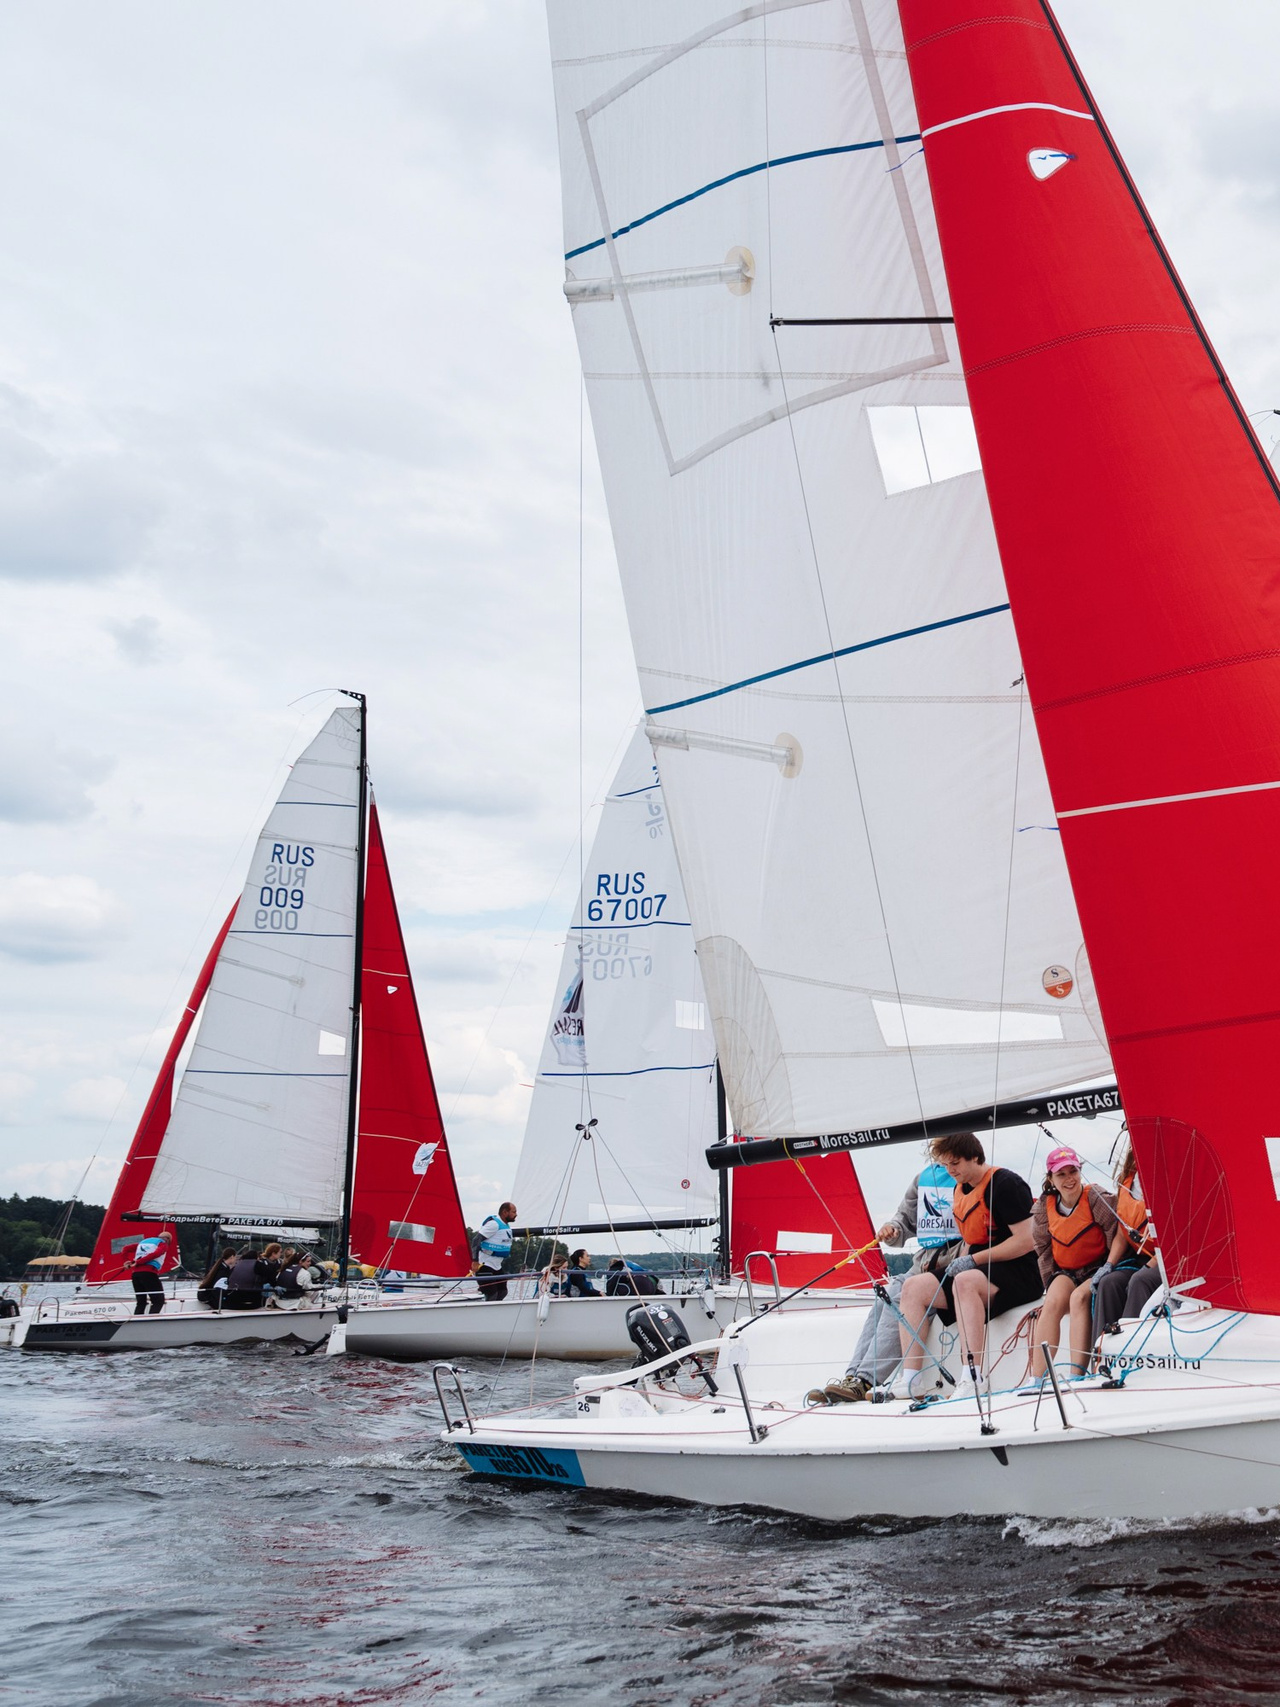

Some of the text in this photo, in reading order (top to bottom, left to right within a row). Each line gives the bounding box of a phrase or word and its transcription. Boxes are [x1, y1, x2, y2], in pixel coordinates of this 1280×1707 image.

[271, 843, 315, 867] RUS
[596, 871, 646, 896] RUS
[260, 886, 304, 909] 009
[587, 894, 667, 922] 67007
[819, 1128, 890, 1149] MoreSail.ru
[542, 1226, 580, 1234] MoreSail.ru
[577, 1401, 591, 1413] 26
[488, 1459, 521, 1474] RUS
[549, 1462, 570, 1479] 26
